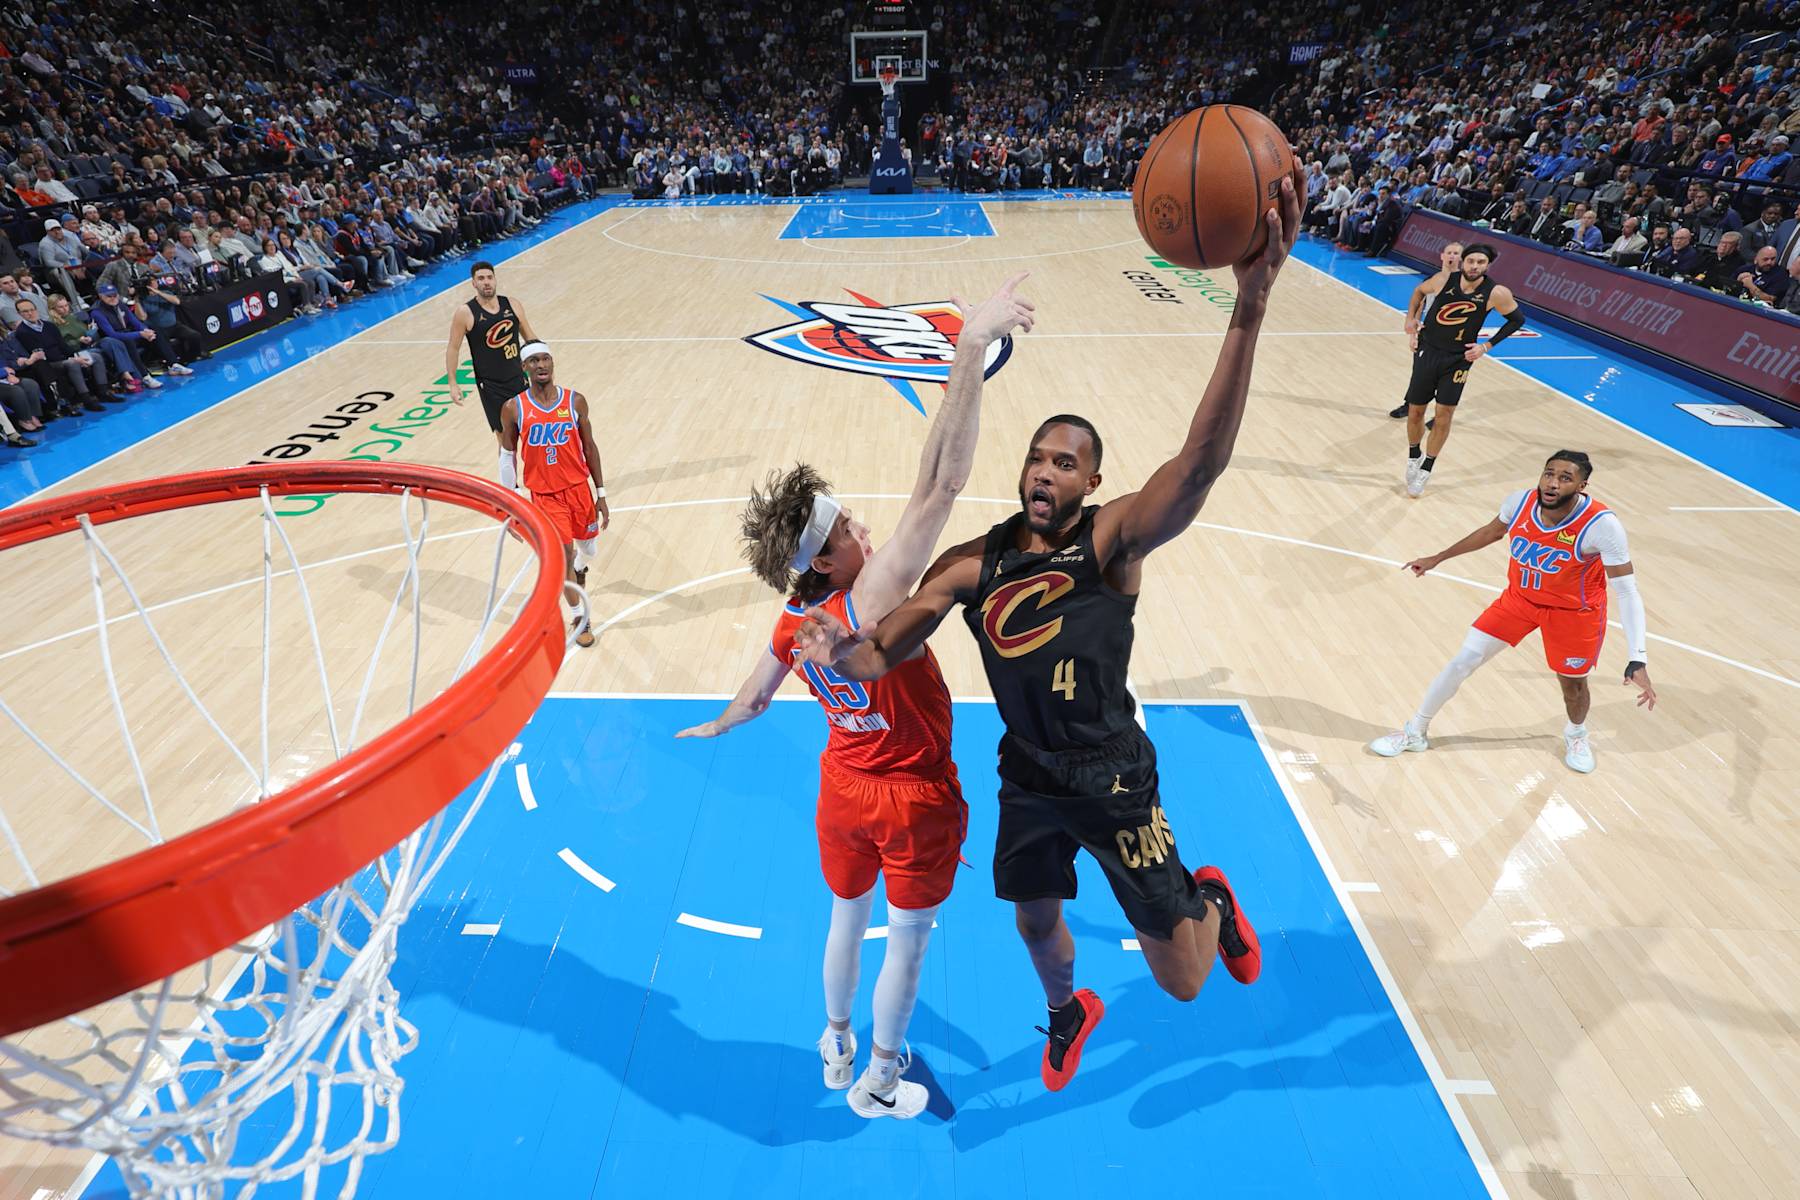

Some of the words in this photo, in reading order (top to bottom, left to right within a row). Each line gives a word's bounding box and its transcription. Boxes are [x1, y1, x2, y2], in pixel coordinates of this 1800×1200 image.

[1122, 270, 1184, 304] center
[1524, 264, 1601, 309] Emirates
[1598, 289, 1634, 318] FLY
[1621, 298, 1684, 336] BETTER
[207, 320, 220, 330] TNT
[1455, 328, 1465, 341] 1
[504, 343, 518, 360] 20
[1726, 331, 1800, 385] Emir
[528, 421, 574, 447] OKC
[546, 447, 557, 465] 2
[1051, 554, 1085, 563] CLIFFS
[1510, 535, 1572, 574] OKC
[1519, 567, 1542, 590] 11
[802, 659, 870, 710] 15
[1051, 657, 1077, 701] 4
[1115, 806, 1175, 869] CAVS
